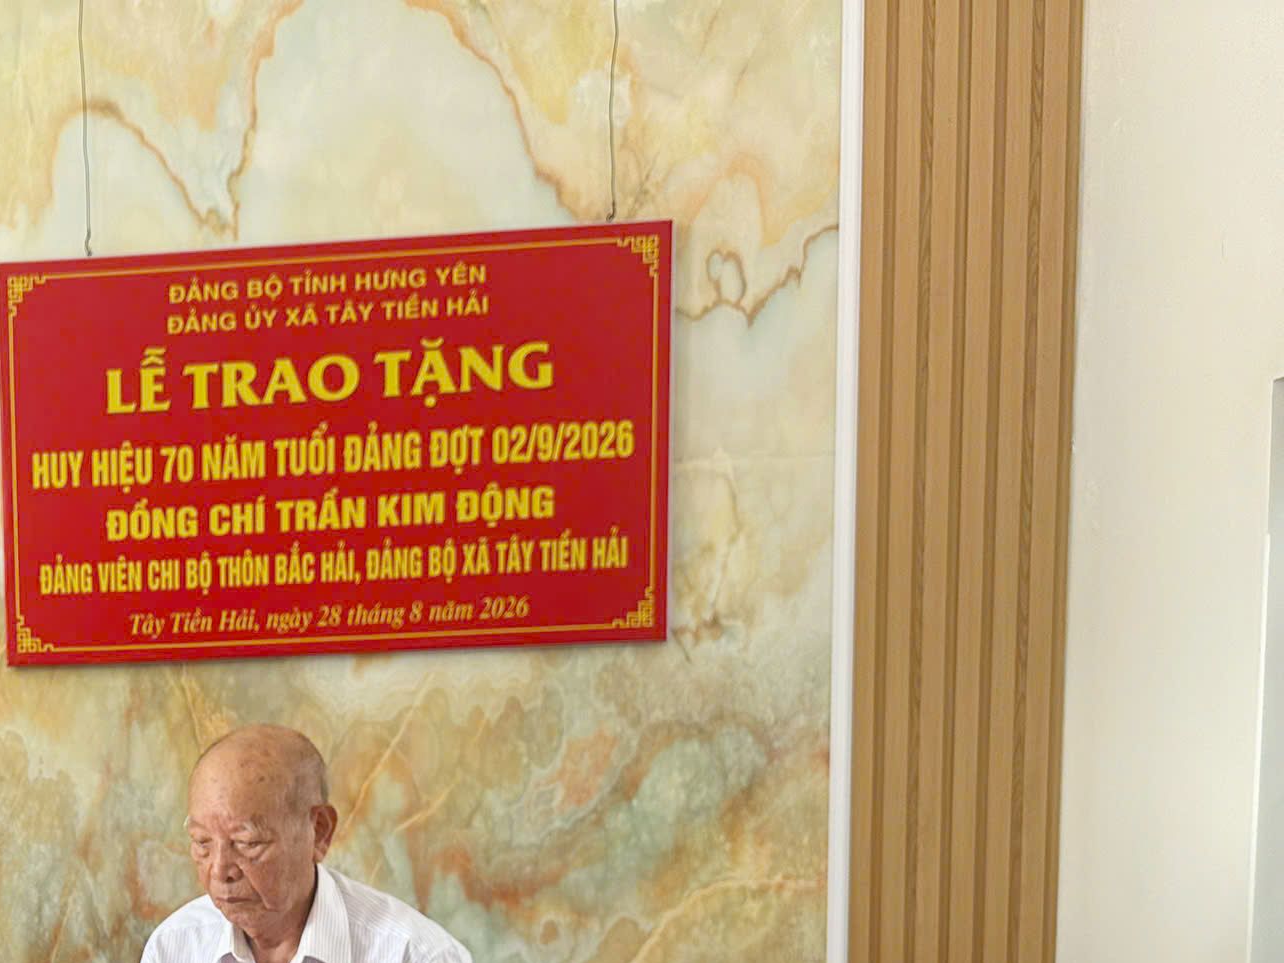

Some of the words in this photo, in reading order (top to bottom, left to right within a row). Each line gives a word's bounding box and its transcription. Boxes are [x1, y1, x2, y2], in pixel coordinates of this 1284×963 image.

[168, 276, 239, 304] ĐẢNG
[246, 274, 283, 300] BỘ
[289, 268, 347, 295] TỈNH
[354, 267, 426, 290] HƯNG
[435, 260, 486, 286] YÊN
[167, 306, 236, 334] ĐẢNG
[244, 304, 277, 330] ỦY
[285, 304, 318, 326] XÃ
[325, 300, 373, 324] TÂY
[447, 288, 489, 316] HẢI
[106, 347, 171, 414] LỄ
[182, 354, 360, 410] TRAO
[373, 337, 554, 408] TẶNG
[31, 451, 84, 489] HUY
[91, 440, 153, 493] HIỆU
[160, 445, 194, 483] 70
[202, 435, 266, 481] NĂM
[274, 421, 336, 477] TUỔI
[343, 421, 422, 472] ĐẢNG
[430, 424, 485, 475] ĐỢT
[492, 419, 635, 464] 02/9/2026
[208, 495, 266, 536] CHÍ
[377, 491, 446, 527] KIM
[455, 481, 556, 528] ĐỘNG
[39, 553, 93, 595] ĐẢNG
[97, 554, 142, 592] VIÊN
[147, 559, 181, 591] CHI
[185, 551, 213, 596] BỘ
[217, 548, 270, 588] THÔN
[274, 541, 316, 585] BẮC
[320, 539, 361, 585] HẢI,
[366, 535, 422, 581] ĐẢNG
[428, 537, 456, 584] BỘ
[462, 536, 490, 576] XÃ
[495, 534, 535, 574] TÂY
[592, 525, 629, 569] HẢI
[130, 613, 165, 639] Tây
[266, 610, 313, 633] ngày
[317, 605, 341, 627] 28
[347, 602, 405, 629] tháng
[409, 601, 423, 623] 8
[429, 602, 474, 623] năm
[479, 595, 531, 620] 2026
